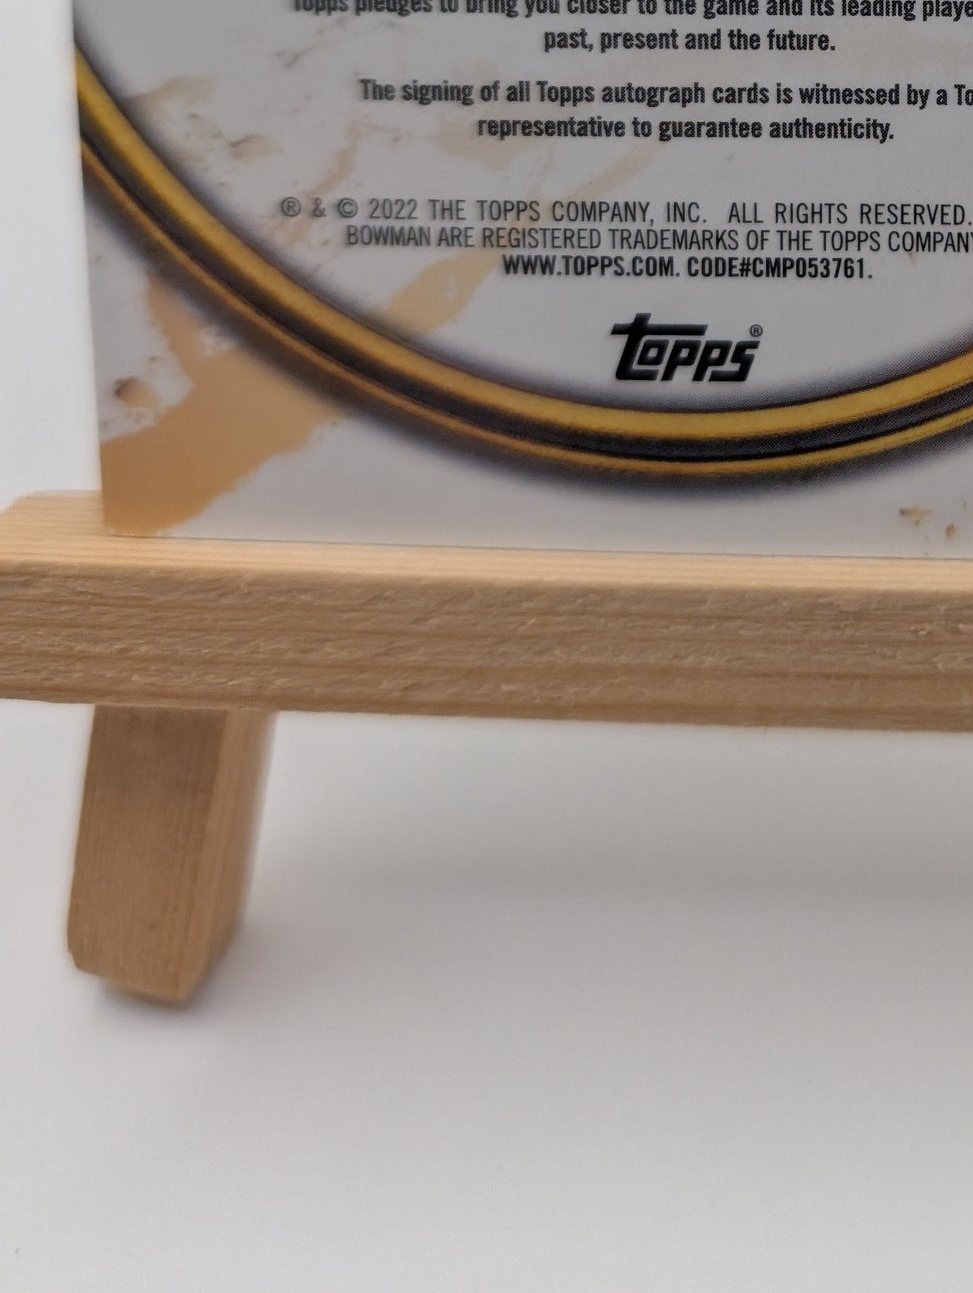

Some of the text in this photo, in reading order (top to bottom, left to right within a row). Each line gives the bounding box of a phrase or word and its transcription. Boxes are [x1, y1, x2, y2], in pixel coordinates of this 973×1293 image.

[543, 28, 837, 53] past, present and the future.
[358, 79, 395, 102] The
[402, 80, 474, 106] signing
[480, 80, 501, 103] of
[506, 81, 530, 103] all
[536, 81, 595, 107] Topps
[601, 82, 706, 108] autograph
[712, 82, 769, 105] cards
[776, 82, 793, 105] is
[799, 83, 900, 106] witnessed
[907, 84, 930, 111] by
[936, 88, 948, 106] a
[477, 115, 895, 144] representative to guarantee authenticity.
[309, 198, 327, 218] &
[368, 198, 418, 220] 2022
[428, 199, 466, 221] THE
[476, 200, 541, 222] TOPPS
[551, 201, 655, 226] COMPANY,
[666, 202, 707, 224] INC.
[728, 202, 764, 224] ALL
[775, 202, 849, 225] RIGHTS
[859, 203, 973, 227] RESERVED.
[346, 225, 431, 247] BOWMAN
[438, 226, 475, 248] ARE
[483, 226, 602, 249] REGISTERED
[610, 228, 738, 251] TRADEMARKS
[746, 229, 770, 251] OF
[777, 230, 813, 252] THE
[820, 230, 881, 253] TOPPS
[502, 254, 873, 280] WWW.TOPPS.COM. CODE#CMP053761.
